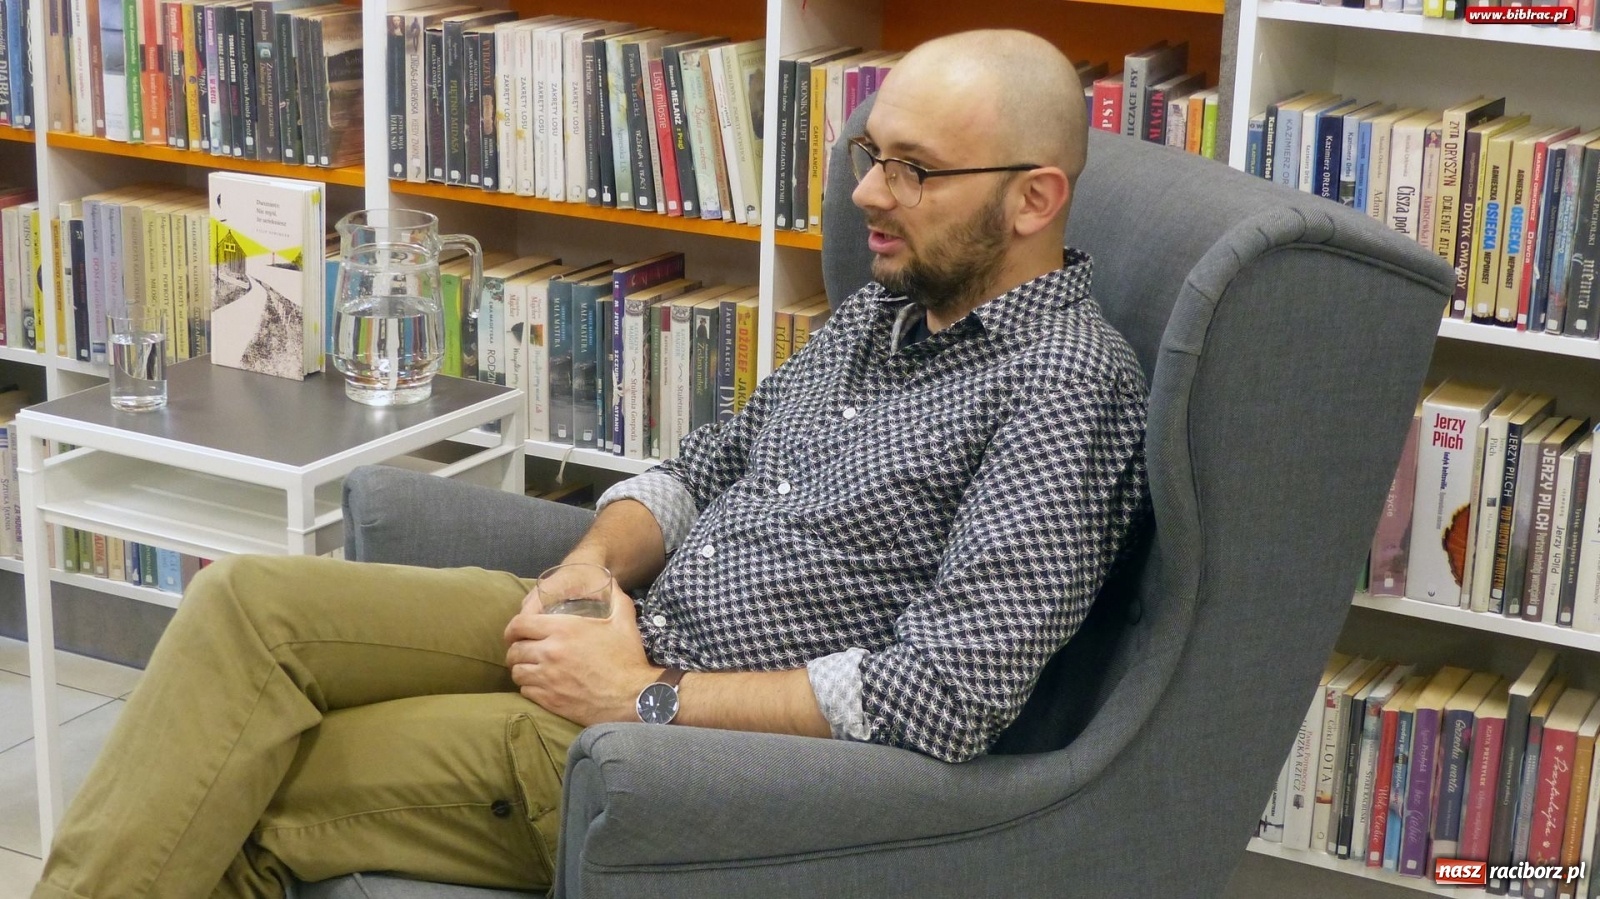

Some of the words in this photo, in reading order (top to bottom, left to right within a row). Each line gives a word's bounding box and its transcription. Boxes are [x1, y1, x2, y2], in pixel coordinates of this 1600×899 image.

[172, 36, 181, 76] Januszewska
[482, 39, 491, 88] WYBACZENIE
[628, 53, 636, 77] Paweł
[0, 60, 9, 106] DIABŁA
[242, 63, 250, 95] Ochronka
[410, 54, 420, 115] LINGAS-ŁONIEWSKA
[503, 74, 511, 107] ZAKRĘTY
[585, 55, 593, 95] Herbaciarz
[652, 71, 663, 91] Listy
[1130, 69, 1138, 88] PSY
[210, 87, 218, 104] sercu
[448, 79, 458, 116] PIĘTNO
[520, 77, 528, 108] ZAKRĘTY
[537, 81, 545, 112] ZAKRĘTY
[572, 81, 580, 113] ZAKRĘTY
[631, 83, 640, 117] Lisicki
[799, 80, 808, 116] MONIKA
[503, 108, 511, 127] LOSU
[572, 116, 580, 135] LOSU
[657, 93, 667, 129] miłosne
[671, 90, 683, 125] MELANŻ
[677, 133, 685, 150] Pragi
[1102, 98, 1114, 128] PSY
[1149, 90, 1164, 140] MAGIK
[450, 117, 459, 154] MIDASA
[551, 118, 559, 137] LOSU
[780, 118, 788, 140] TWOJA
[799, 119, 808, 143] LUFT
[1266, 116, 1275, 156] Kazimierz
[1449, 120, 1460, 139] ZYTA
[780, 140, 788, 171] ZAGŁADA
[1282, 119, 1294, 169] KAZIMIERZ
[1323, 135, 1333, 170] Kazimierz
[1346, 132, 1354, 160] Kazimierz
[811, 148, 819, 179] BLANCHE
[1265, 158, 1273, 179] Orłoś
[1442, 143, 1458, 187] ORYSZYN
[1533, 152, 1543, 181] MARCIN
[779, 179, 787, 204] RZYMIE
[1321, 172, 1331, 198] ORŁOŚ
[1489, 164, 1500, 201] AGNIESZKA
[1514, 169, 1525, 205] AGNIESZKA
[1372, 189, 1384, 218] Adam
[1396, 186, 1416, 213] Cisza
[1440, 196, 1453, 234] OCALENIE
[1530, 182, 1541, 220] OSIKOWICZ
[1393, 216, 1410, 234] pod
[1461, 203, 1474, 238] DOTYK
[1482, 201, 1499, 250] OSIECKA
[1507, 206, 1525, 254] OSIECKA
[1587, 203, 1599, 246] PACHOLSKI
[1525, 230, 1534, 264] Dawca
[92, 257, 100, 279] DOM
[110, 261, 119, 284] DOM
[1455, 241, 1470, 289] GWIAZDY
[1481, 251, 1492, 285] NEPONSET
[1505, 256, 1516, 289] NEPONSET
[150, 278, 158, 302] MIŁOŚĆ
[162, 273, 170, 307] POWROTY
[177, 275, 185, 309] POWROTY
[553, 297, 561, 317] MAŁA
[580, 302, 588, 322] MAŁA
[724, 307, 733, 335] JAKUB
[553, 319, 562, 348] MATURA
[580, 324, 588, 353] MATURA
[775, 325, 790, 360] rdza
[695, 342, 705, 370] Zesłana
[724, 337, 733, 377] MAŁECKI
[738, 327, 751, 373] DŻOZEF
[629, 377, 638, 410] Stuletnia
[696, 371, 705, 395] miłość
[677, 384, 685, 416] Stuletnia
[628, 410, 638, 441] Gospoda
[1433, 413, 1466, 434] Jerzy
[1432, 431, 1464, 450] Pilch
[1488, 437, 1499, 457] Pilch
[1507, 432, 1518, 463] JERZY
[1442, 451, 1450, 466] Indyk
[1540, 448, 1557, 491] JERZY
[1, 478, 10, 504] SZTUKA
[1502, 466, 1515, 498] PILCH
[1386, 494, 1399, 517] życie
[1500, 505, 1511, 522] POD
[1535, 492, 1552, 530] PILCH
[1497, 523, 1510, 556] MOCNYM
[1553, 525, 1565, 548] Jerzy
[1493, 557, 1506, 589] ANIOŁEM
[1550, 552, 1562, 574] Pilch
[1399, 744, 1406, 752] do
[1449, 719, 1465, 760] Grzechu
[1484, 725, 1492, 745] AGATA
[1293, 761, 1303, 791] RZECZ
[1321, 743, 1336, 782] LOTA
[1445, 762, 1458, 793] warta
[1479, 747, 1490, 786] PRZYBYŁEK
[1375, 786, 1388, 809] Wolę
[1372, 812, 1387, 844] Ciebie
